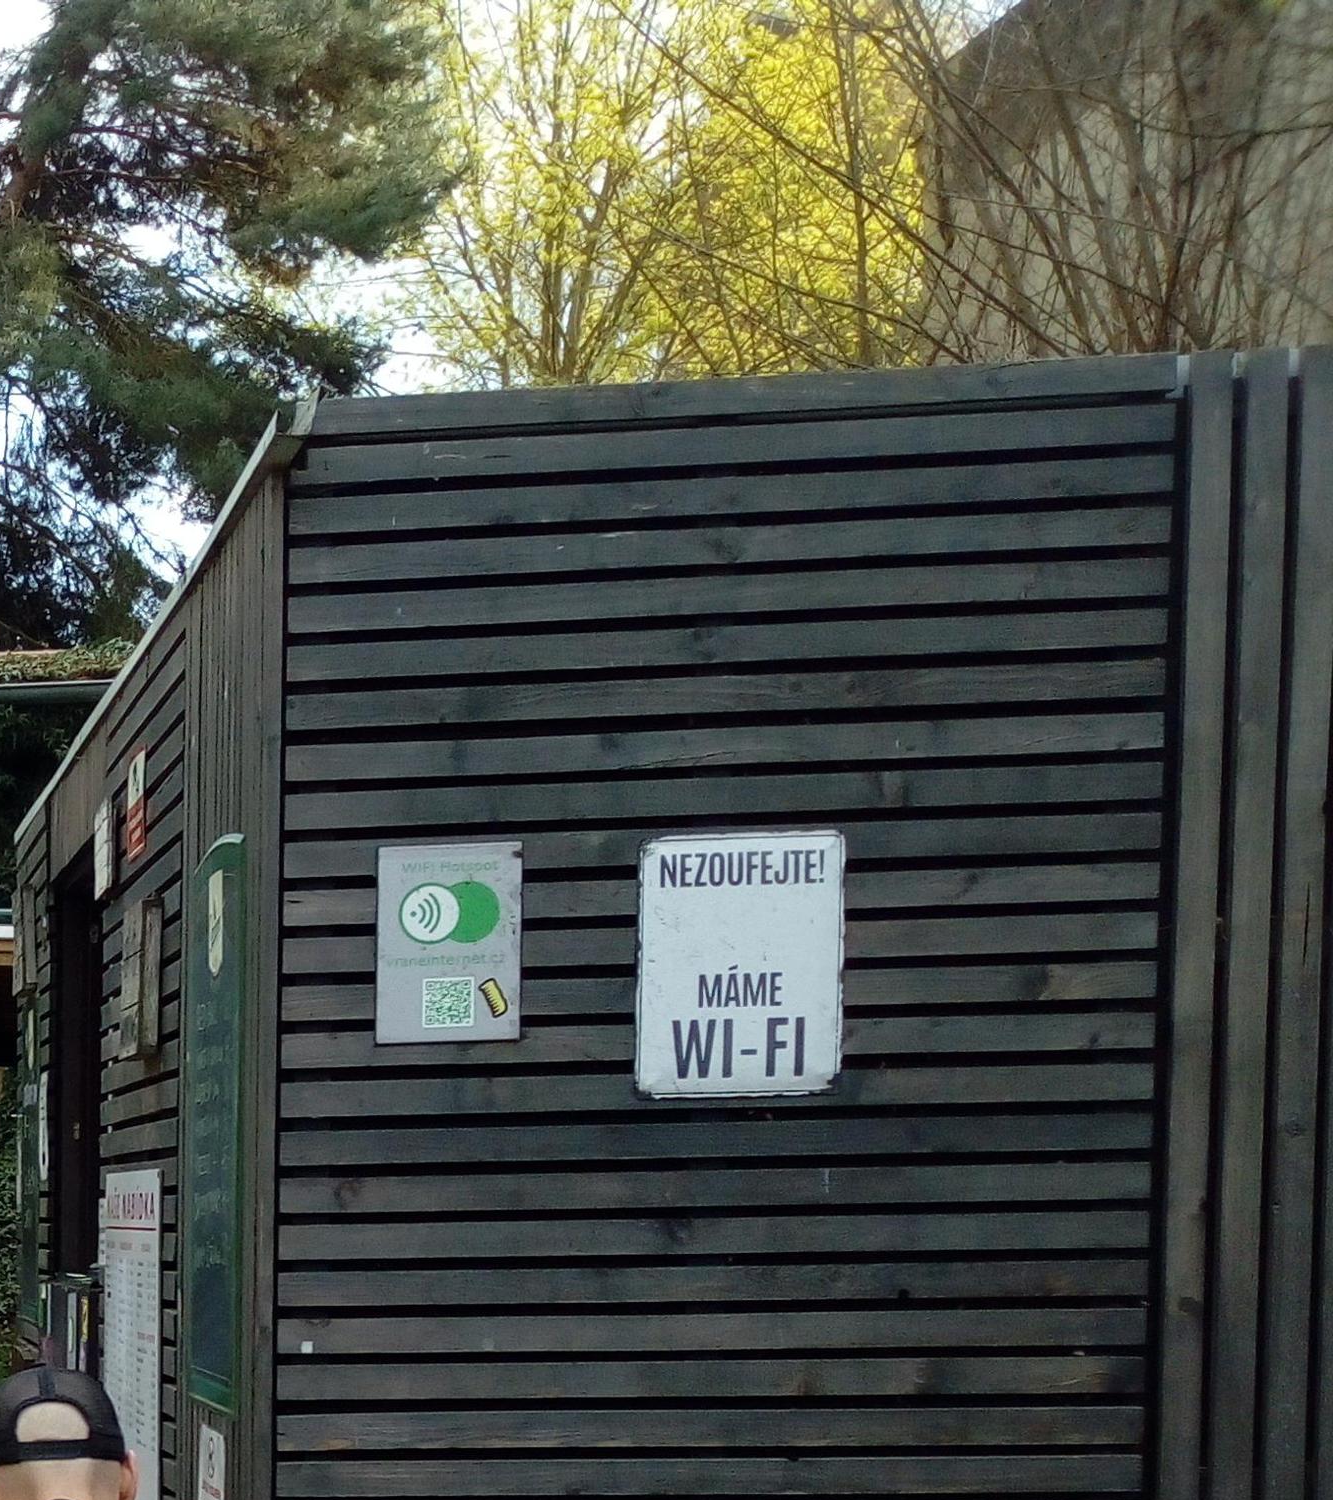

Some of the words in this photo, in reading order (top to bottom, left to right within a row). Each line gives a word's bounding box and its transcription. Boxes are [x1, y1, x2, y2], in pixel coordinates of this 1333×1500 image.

[659, 849, 827, 889] NEZOUFEJTE!
[698, 963, 784, 1008] MÁME
[672, 1016, 806, 1080] WI-FI
